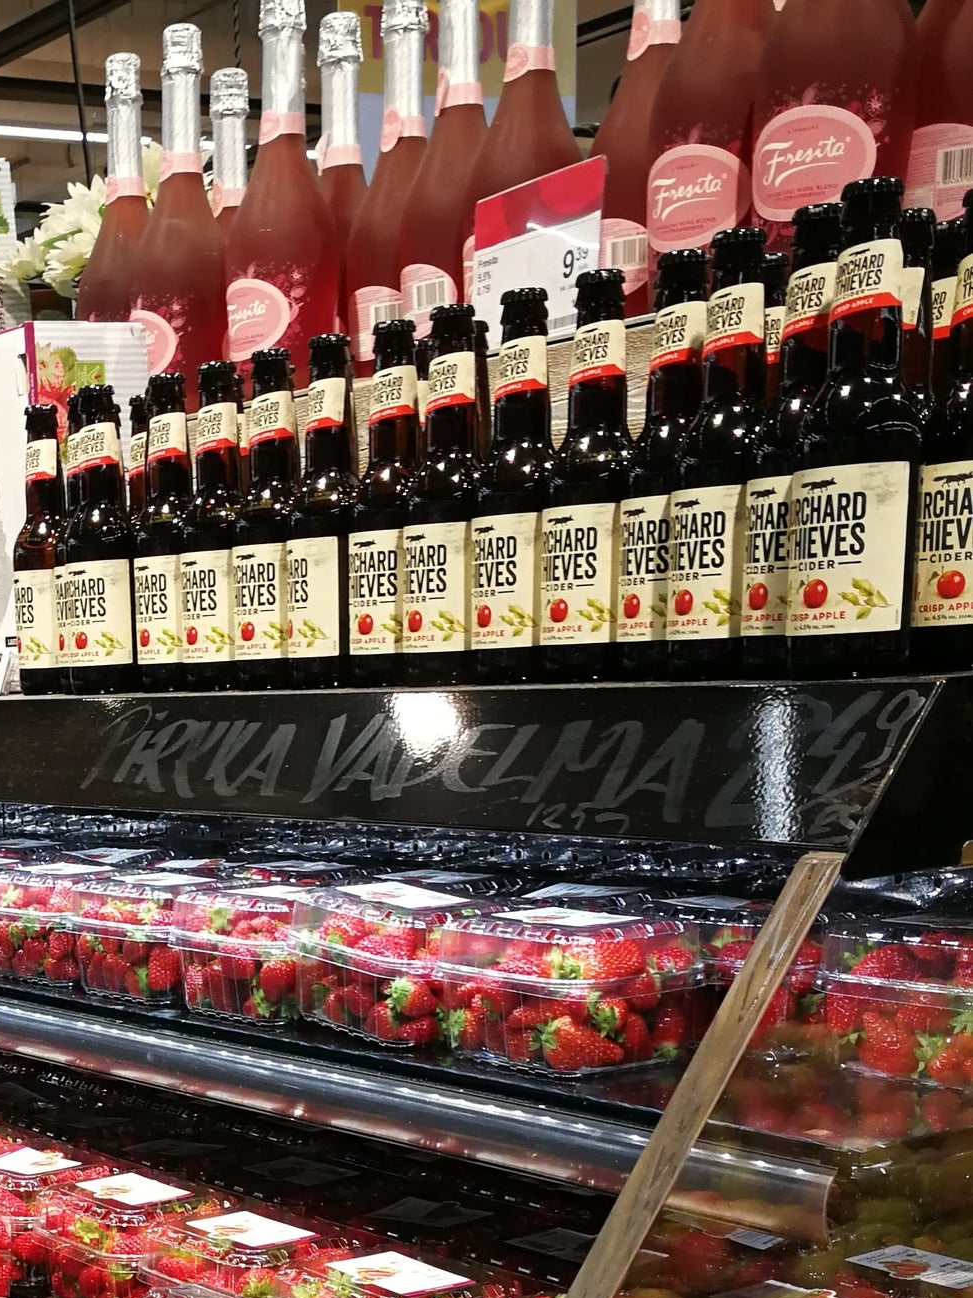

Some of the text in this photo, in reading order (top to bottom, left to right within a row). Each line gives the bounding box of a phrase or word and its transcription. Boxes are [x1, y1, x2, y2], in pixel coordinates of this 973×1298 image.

[760, 136, 845, 186] Fresita
[651, 172, 723, 220] Fresita
[838, 254, 885, 275] ORCHARD
[836, 269, 882, 298] THIEVES
[929, 551, 973, 563] CIDER
[745, 564, 775, 575] CIDER
[798, 559, 836, 572] CIDER
[671, 572, 699, 583] CIDER
[545, 583, 574, 592] CIDER
[918, 603, 945, 613] CRISP
[755, 613, 783, 622] APPLE
[812, 611, 846, 621] APPLE
[556, 624, 583, 633] APPLE
[629, 621, 654, 629] APPLE
[681, 618, 708, 628] APPLE
